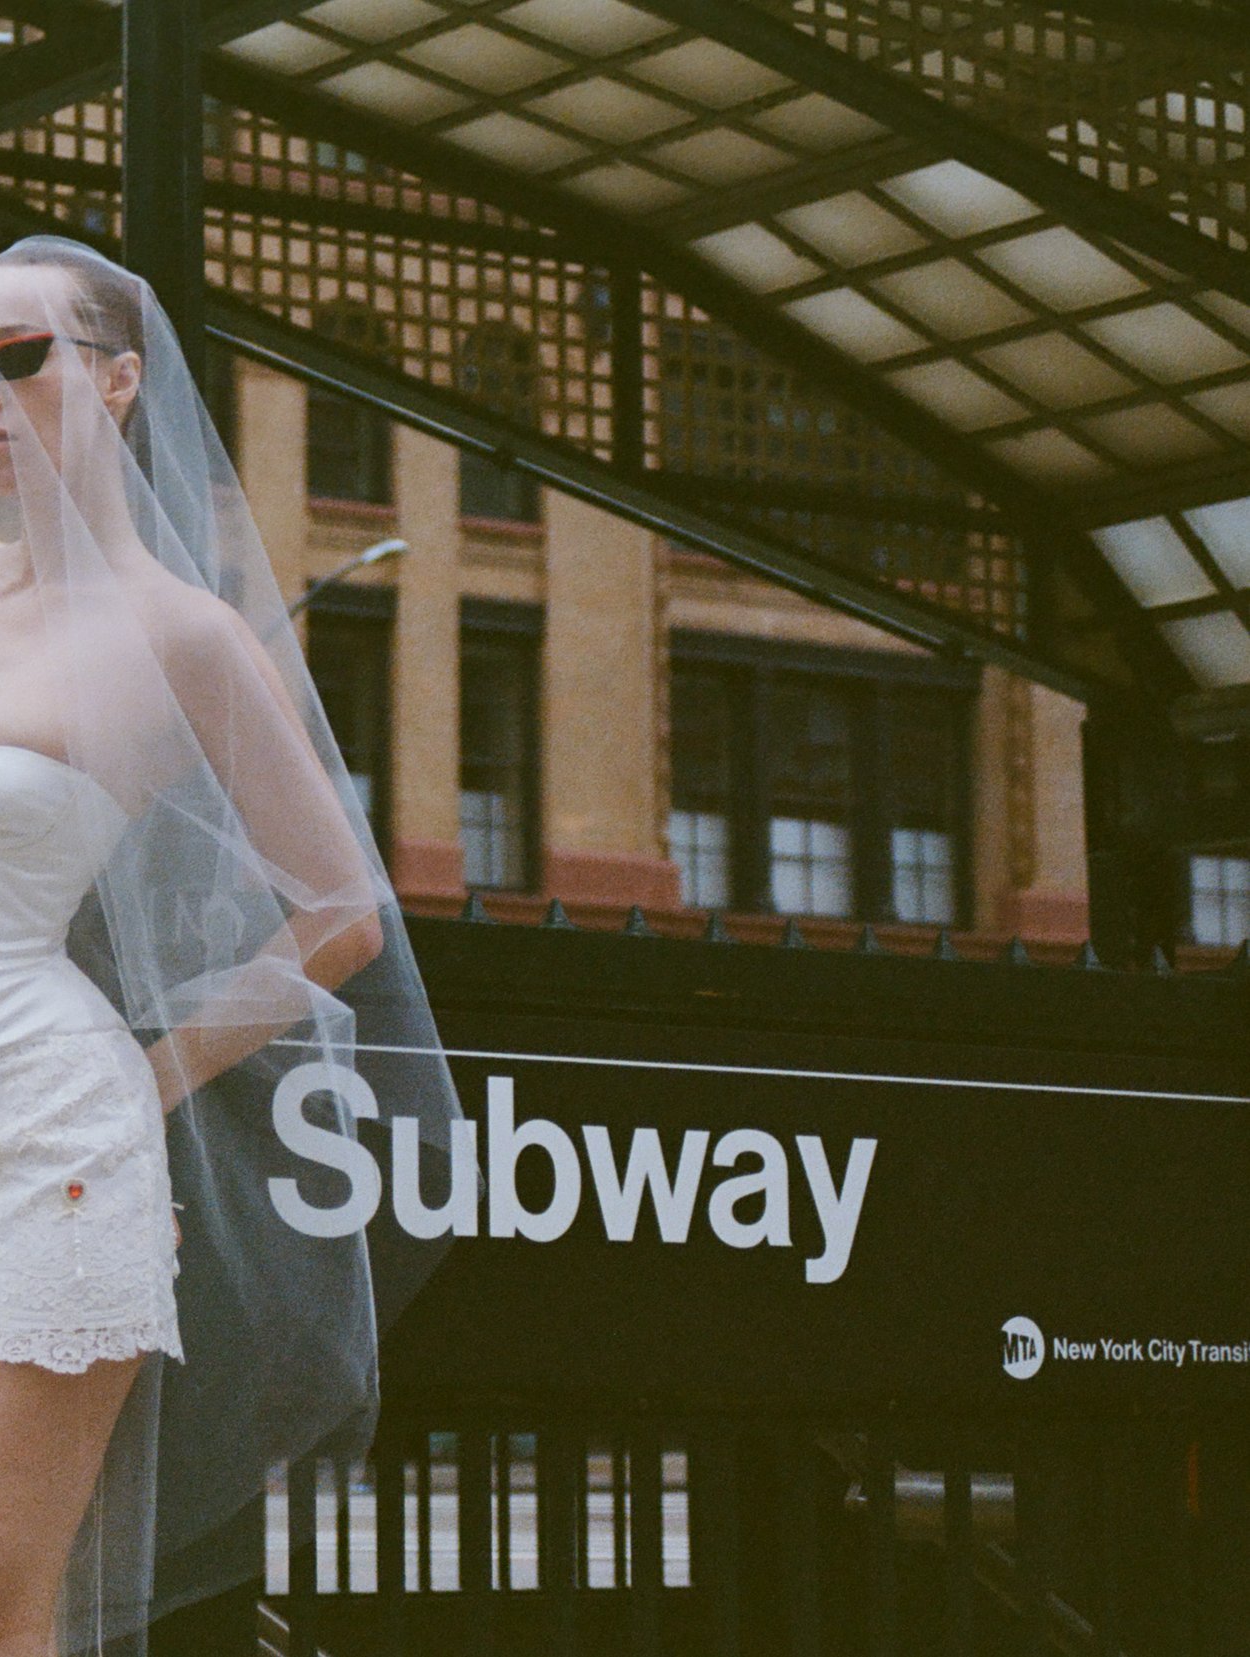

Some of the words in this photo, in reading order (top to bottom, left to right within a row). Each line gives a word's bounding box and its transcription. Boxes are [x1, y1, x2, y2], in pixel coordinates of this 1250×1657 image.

[266, 1062, 878, 1285] Subway
[1054, 1337, 1097, 1360] New
[1100, 1338, 1144, 1361] York
[1148, 1339, 1186, 1368] City
[1188, 1340, 1250, 1363] Transi
